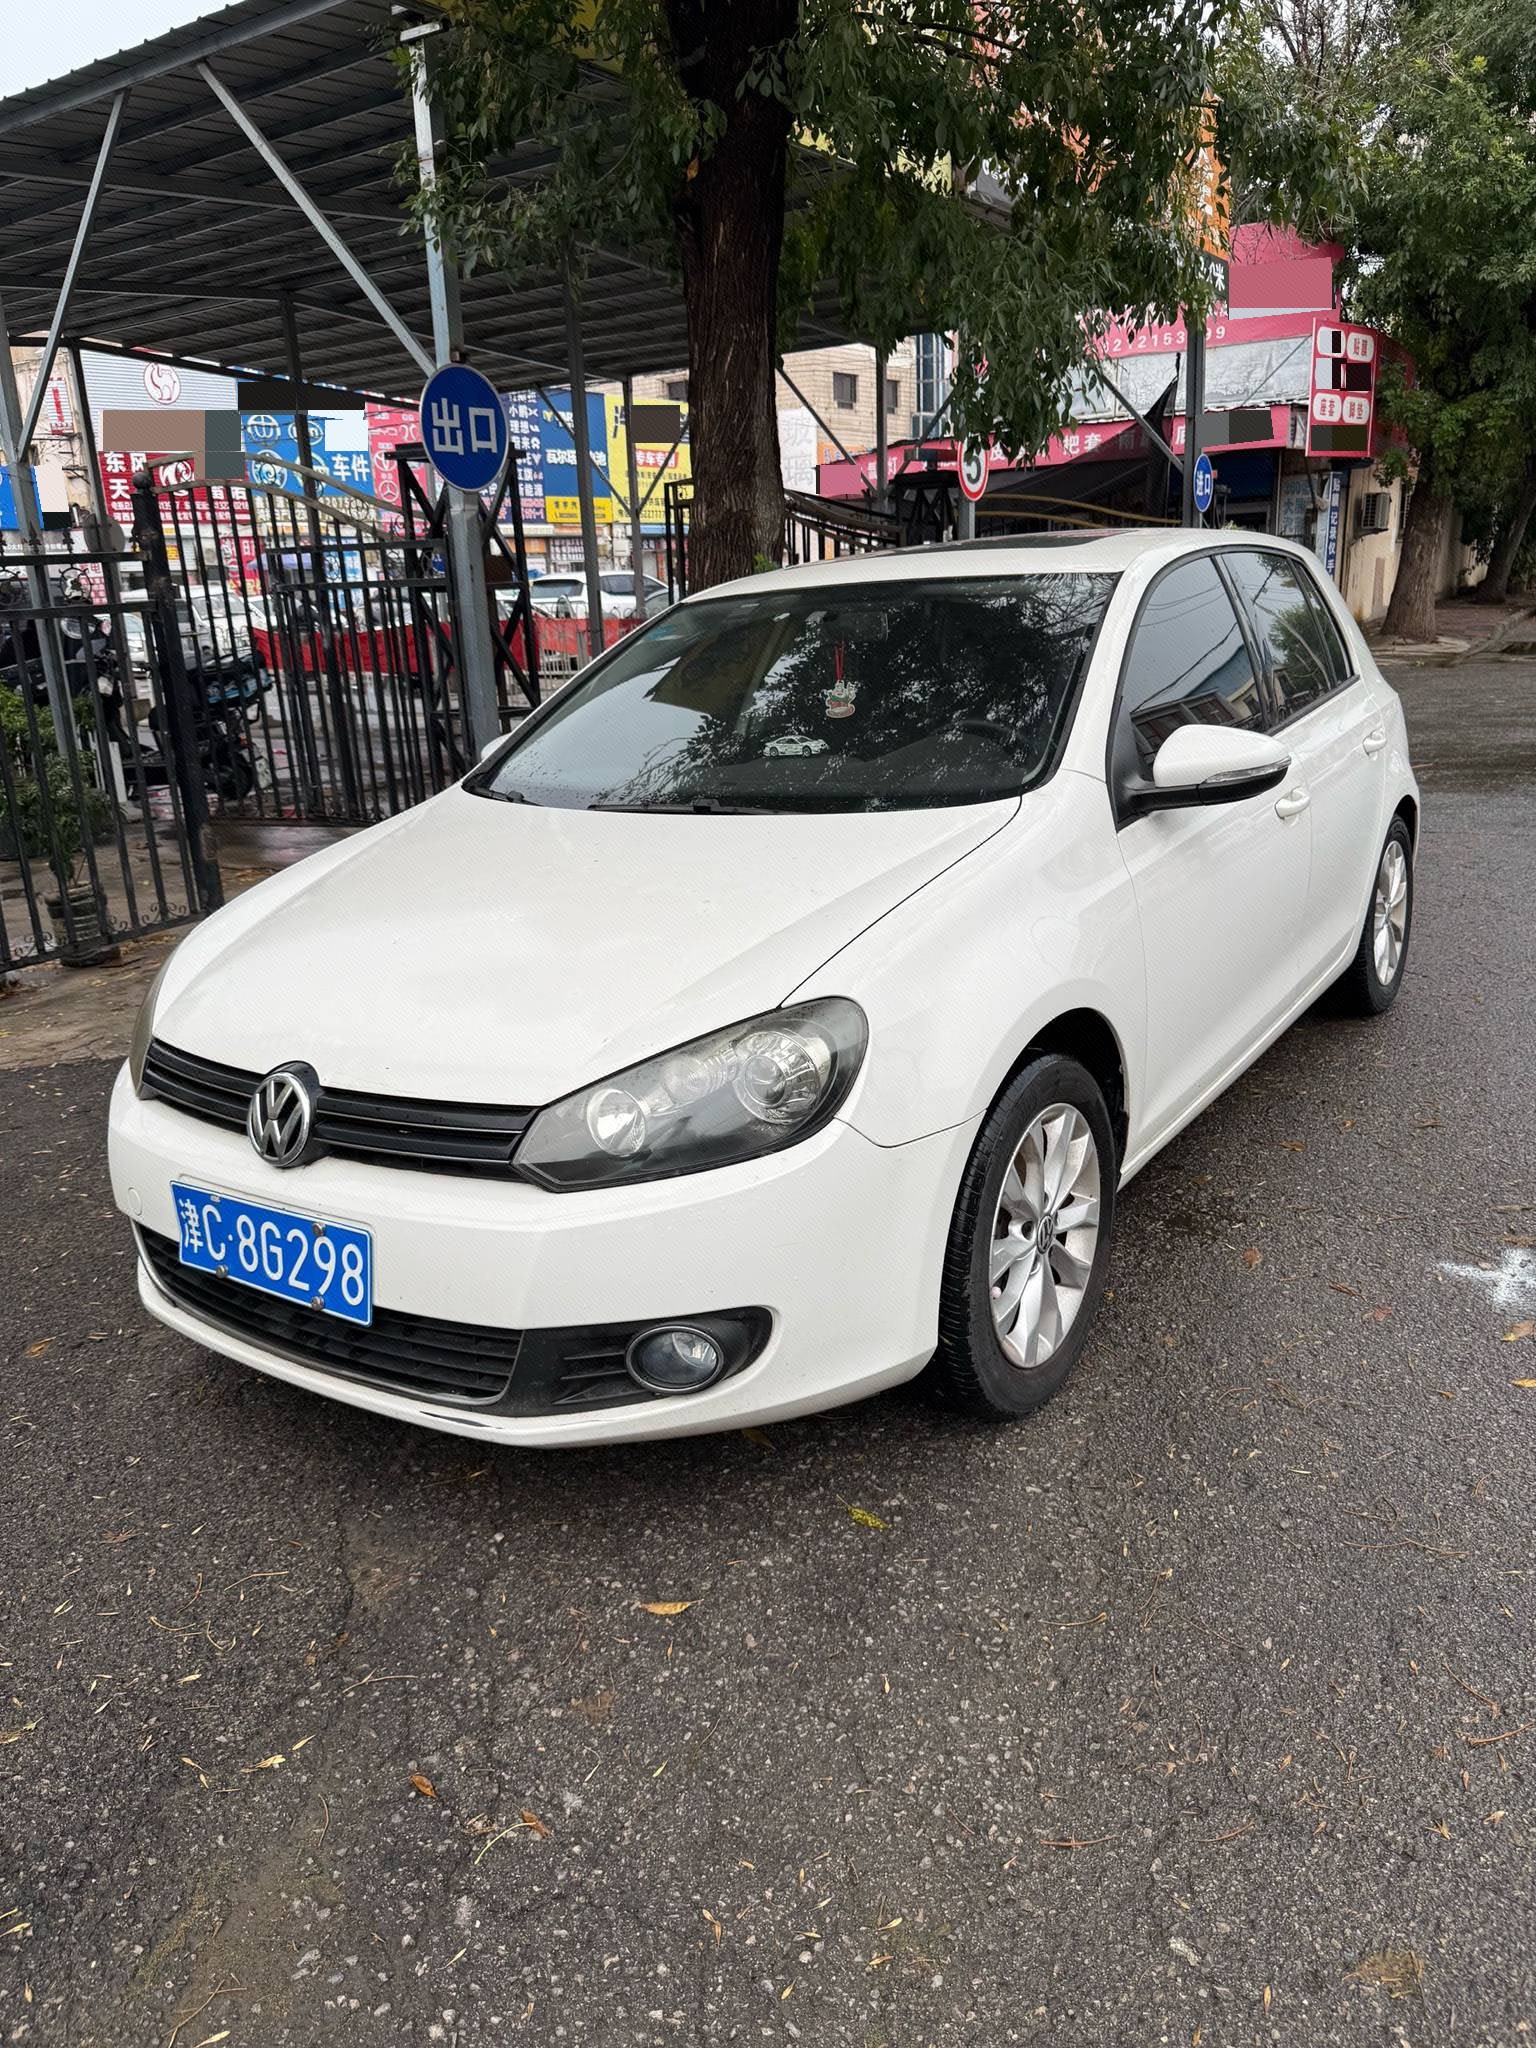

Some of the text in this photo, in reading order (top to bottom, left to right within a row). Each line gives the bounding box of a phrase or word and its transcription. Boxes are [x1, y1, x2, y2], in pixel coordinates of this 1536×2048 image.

[431, 398, 498, 455] 出口
[104, 451, 147, 473] 东风
[331, 453, 370, 482] 车件
